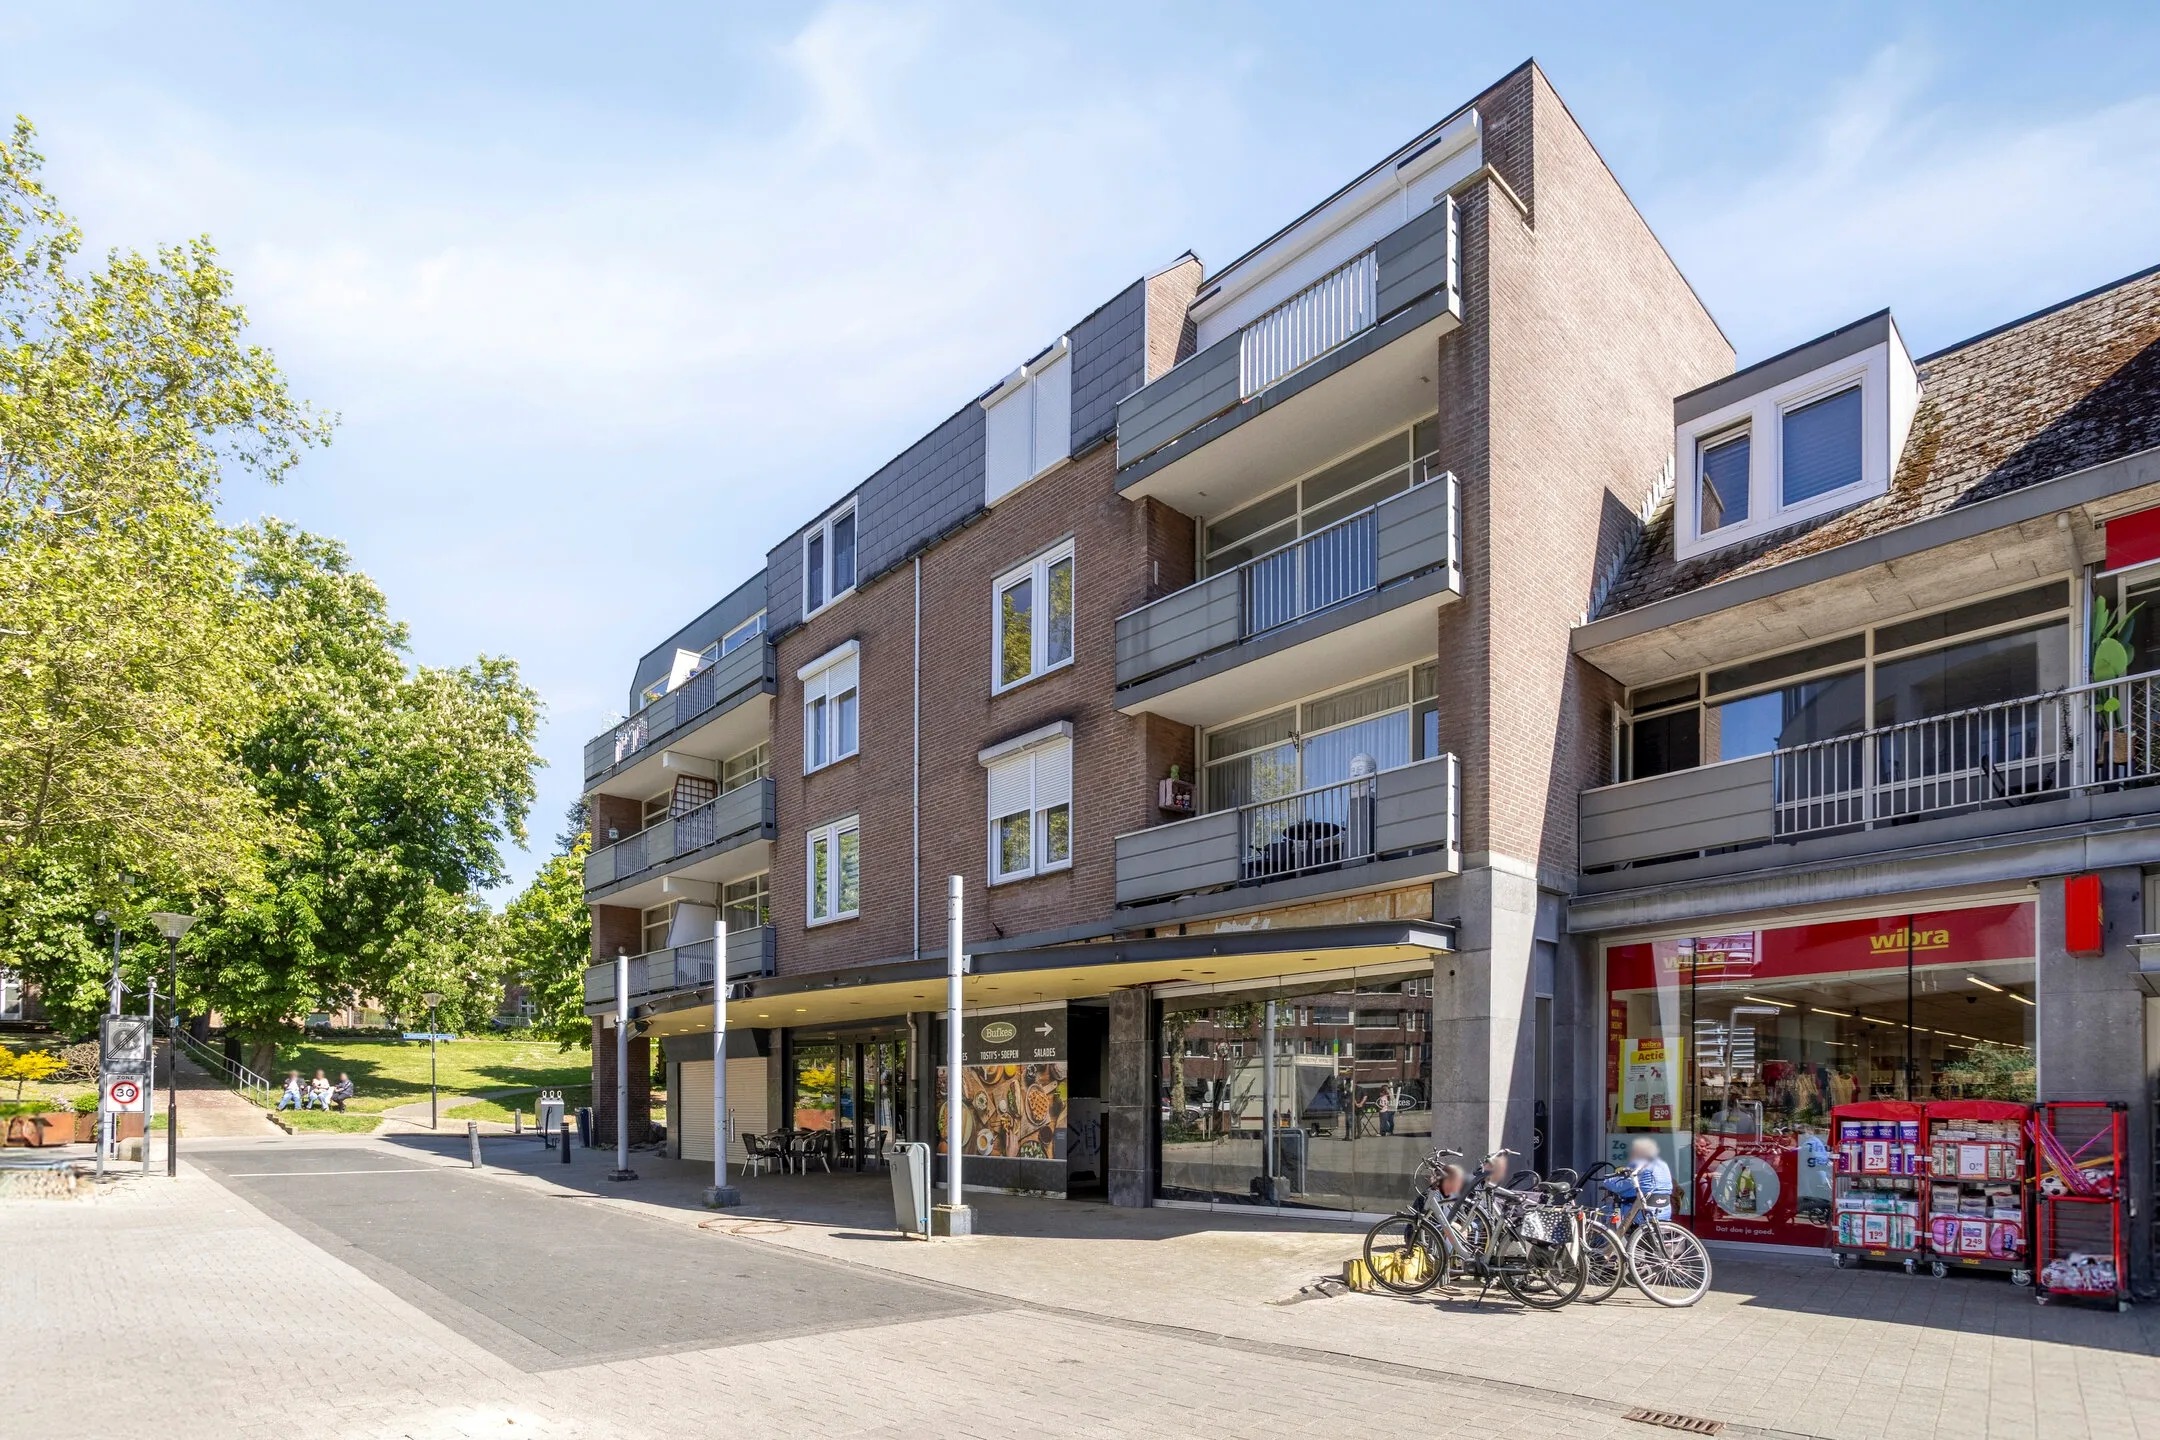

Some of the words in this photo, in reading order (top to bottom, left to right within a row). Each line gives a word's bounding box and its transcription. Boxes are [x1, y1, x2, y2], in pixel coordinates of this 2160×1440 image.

[1869, 927, 1950, 950] wibra
[986, 1027, 1013, 1038] Bufkes
[980, 1050, 998, 1060] TOSTI'S
[1001, 1049, 1019, 1059] SOEPEN
[1033, 1047, 1056, 1058] SALADES
[1638, 1051, 1665, 1061] Actie
[116, 1088, 135, 1097] 30
[1654, 1109, 1669, 1119] 5.00
[1868, 1157, 1884, 1167] 2.79
[1745, 1227, 1752, 1235] je
[1868, 1230, 1884, 1240] 1.99
[1965, 1238, 1983, 1248] 2.49
